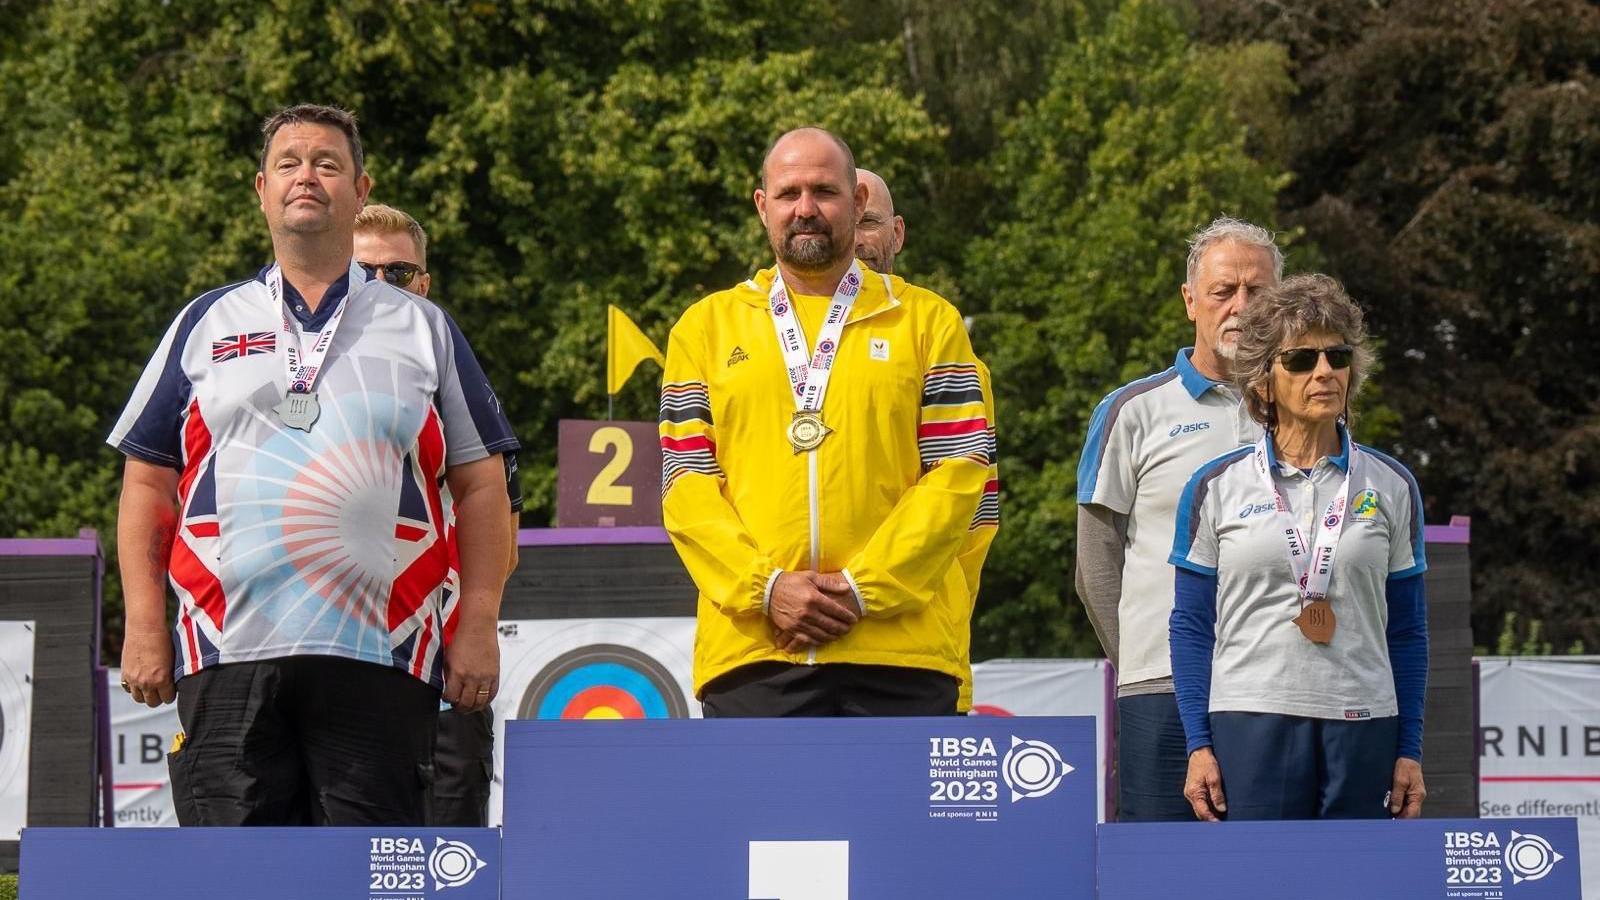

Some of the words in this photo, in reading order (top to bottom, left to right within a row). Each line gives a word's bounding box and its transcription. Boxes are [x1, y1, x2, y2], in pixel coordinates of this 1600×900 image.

[827, 304, 842, 324] RNIB
[287, 347, 298, 372] RNIB
[1182, 421, 1210, 433] asics
[586, 426, 633, 506] 2
[1285, 528, 1301, 556] RNIB
[1319, 546, 1332, 575] RNIB
[930, 737, 998, 757] IBSA
[1480, 725, 1600, 757] RNIB
[930, 758, 960, 767] World
[962, 758, 998, 767] Games
[930, 768, 998, 780] Birmingham
[930, 780, 998, 801] 2023
[1481, 800, 1511, 816] See
[370, 838, 425, 854] IBSA
[1444, 831, 1500, 848] IBSA
[370, 854, 395, 862] World
[396, 854, 425, 862] Games
[1445, 848, 1470, 856] World
[1472, 848, 1501, 856] Games
[369, 863, 425, 872] Birmingham
[1445, 857, 1502, 867] Birmingham
[369, 872, 425, 889] 2023
[1446, 867, 1502, 884] 2023
